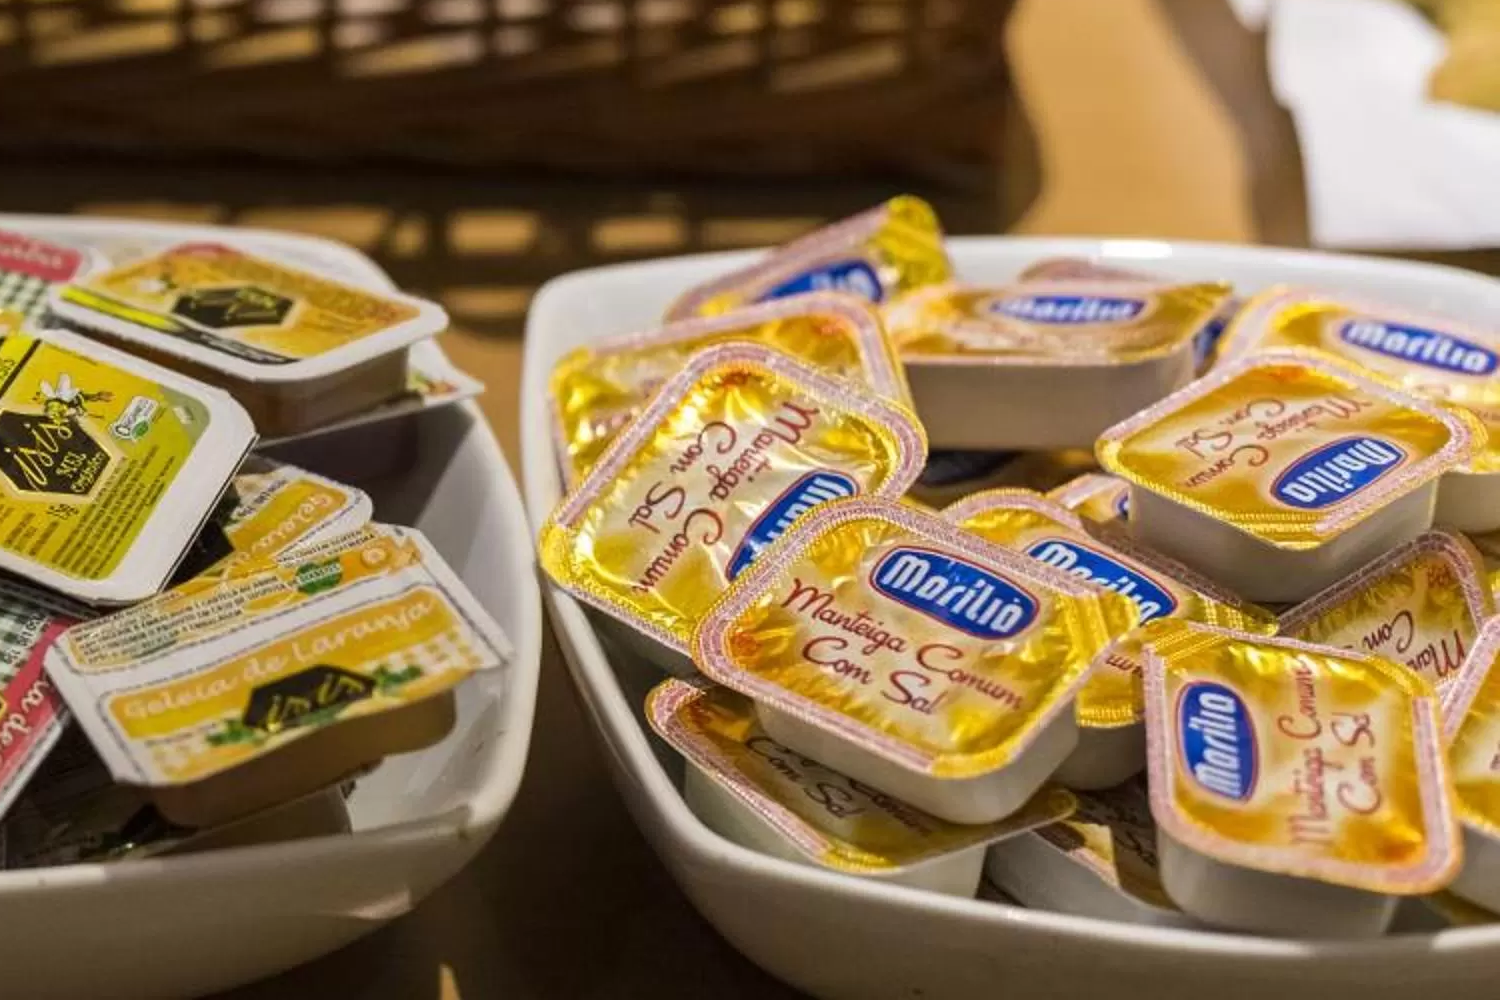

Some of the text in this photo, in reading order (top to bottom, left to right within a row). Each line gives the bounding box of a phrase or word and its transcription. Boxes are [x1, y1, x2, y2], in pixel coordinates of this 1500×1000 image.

[628, 420, 737, 534] Com Sal
[779, 577, 1026, 711] Manteiga Comum
[801, 634, 948, 717] Com Sal
[803, 782, 867, 819] Sal
